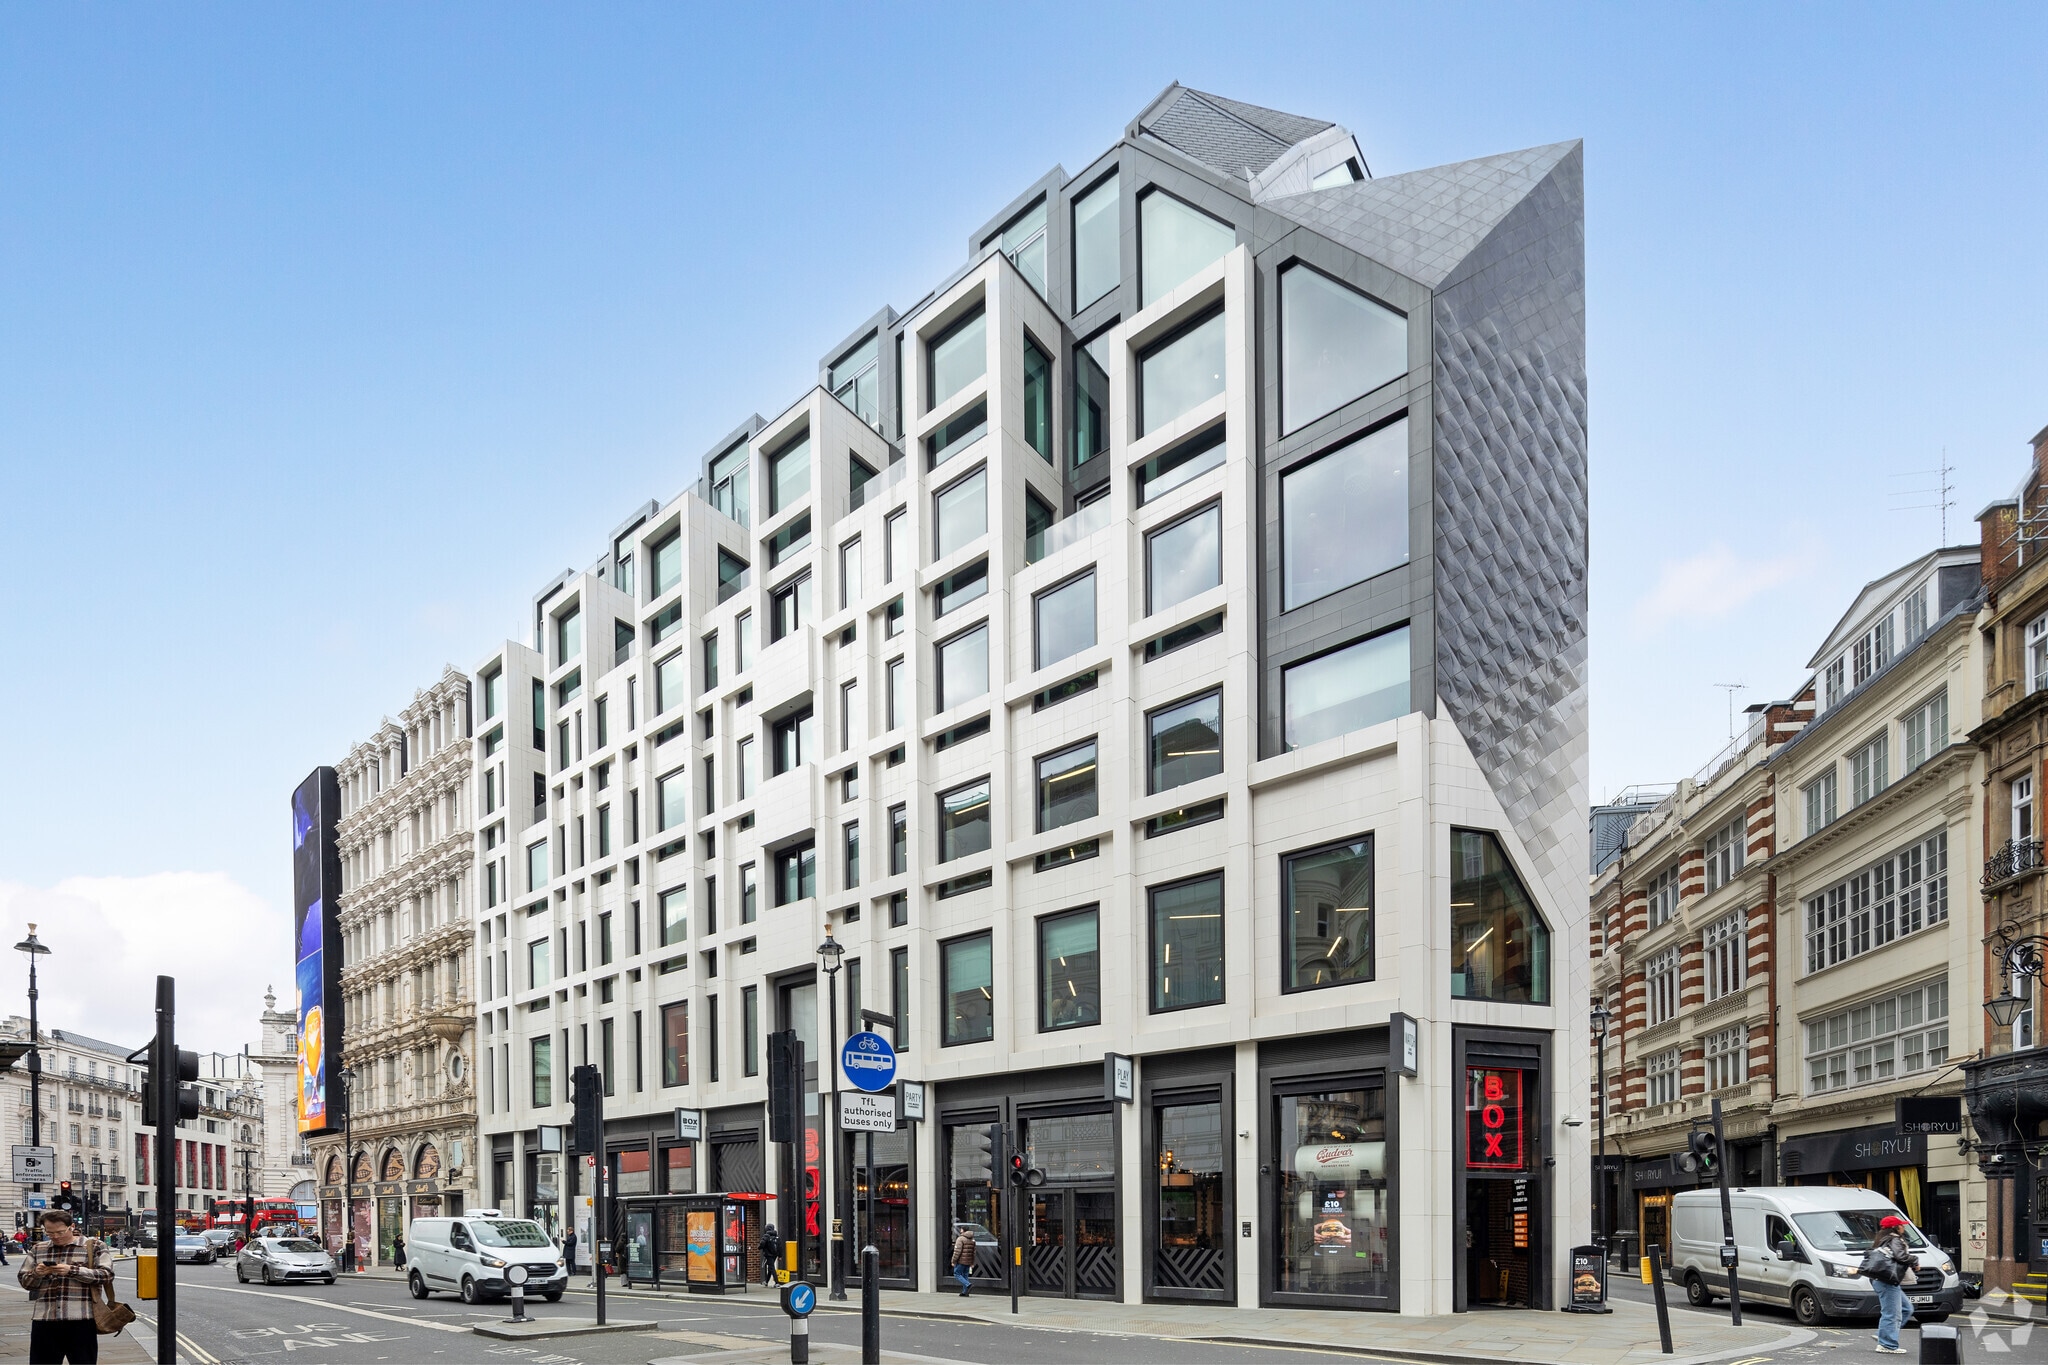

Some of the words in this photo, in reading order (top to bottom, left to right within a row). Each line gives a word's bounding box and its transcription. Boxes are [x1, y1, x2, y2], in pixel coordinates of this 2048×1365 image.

[1117, 1069, 1129, 1081] PLAY
[861, 1097, 876, 1106] TfL
[905, 1092, 922, 1103] PARTY
[844, 1107, 892, 1118] authorised
[1482, 1075, 1505, 1157] BOX
[682, 1117, 698, 1125] BOX
[844, 1117, 870, 1126] buses
[873, 1119, 892, 1129] only
[1325, 1200, 1340, 1208] £10
[1575, 1257, 1588, 1265] £10
[229, 1322, 351, 1339] BUS
